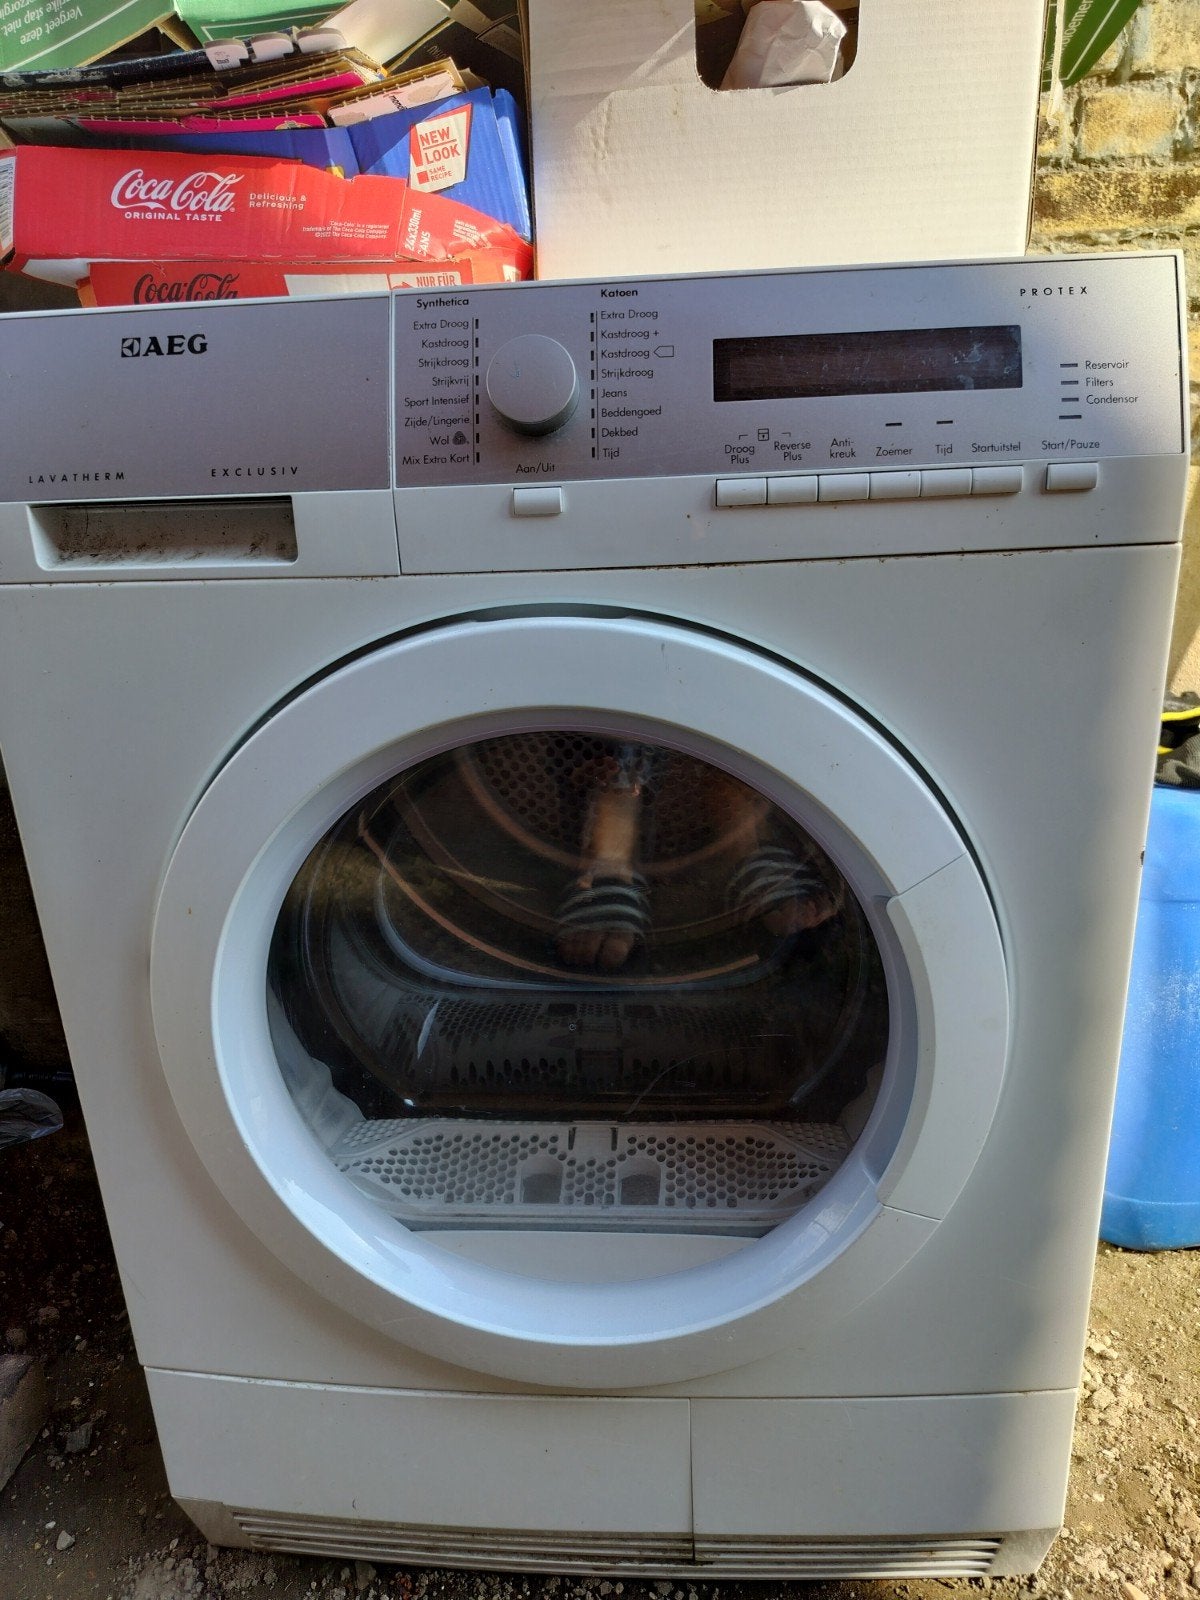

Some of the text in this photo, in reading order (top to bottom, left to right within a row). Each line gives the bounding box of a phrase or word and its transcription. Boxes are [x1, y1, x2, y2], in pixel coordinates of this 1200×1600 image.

[24, 7, 44, 24] stap
[1, 18, 22, 36] niet.
[20, 6, 83, 45] Vergeet deze
[419, 126, 450, 146] NEW
[424, 143, 461, 165] LOOK
[429, 165, 446, 175] SAME
[430, 171, 452, 182] RECIPE
[250, 193, 307, 202] Delicious &
[249, 200, 304, 211] Refreshing
[124, 211, 222, 222] ORIGINAL TASTE
[404, 208, 422, 251] 24x330ml
[416, 273, 455, 288] NUR FÜR
[600, 289, 638, 298] Katoen
[1020, 286, 1088, 296] PROTEX
[416, 297, 469, 310] Synthetica
[601, 309, 658, 320] Extra Droog
[413, 319, 469, 331] Extra Droog
[601, 329, 650, 340] Kastdroog
[143, 333, 208, 357] AEG
[421, 338, 469, 349] Kastdroog
[601, 348, 650, 359] Kastdroog
[418, 357, 469, 370] Strijkdroog
[1085, 359, 1130, 370] Reservoir
[601, 368, 654, 380] Strijkdroog
[432, 376, 469, 388] Strijkvrij
[1085, 377, 1114, 387] Filters
[601, 389, 628, 398] Jeans
[1086, 394, 1139, 405] Condensor
[404, 394, 470, 409] Sport Intensief
[601, 405, 662, 419] Beddengoed
[404, 415, 470, 428] Zijde/Lingerie
[601, 426, 638, 438] Dekbed
[429, 436, 450, 445] Wol
[774, 441, 811, 451] Reverse
[831, 438, 854, 448] Anti-
[1041, 438, 1100, 450] Start/Pauze
[724, 444, 755, 455] Droog
[829, 448, 856, 459] kreuk
[876, 446, 913, 457] Zoemer
[935, 444, 953, 456] Tijd
[971, 441, 1021, 454] Startuitstel
[402, 453, 470, 465] Mix Extra Kort
[602, 448, 620, 460] Tijd
[731, 455, 749, 464] Plus
[783, 451, 802, 461] Plus
[211, 465, 299, 478] EXCLUSIV
[515, 462, 555, 474] Aan/Uit
[28, 471, 125, 484] LAVATHERM
